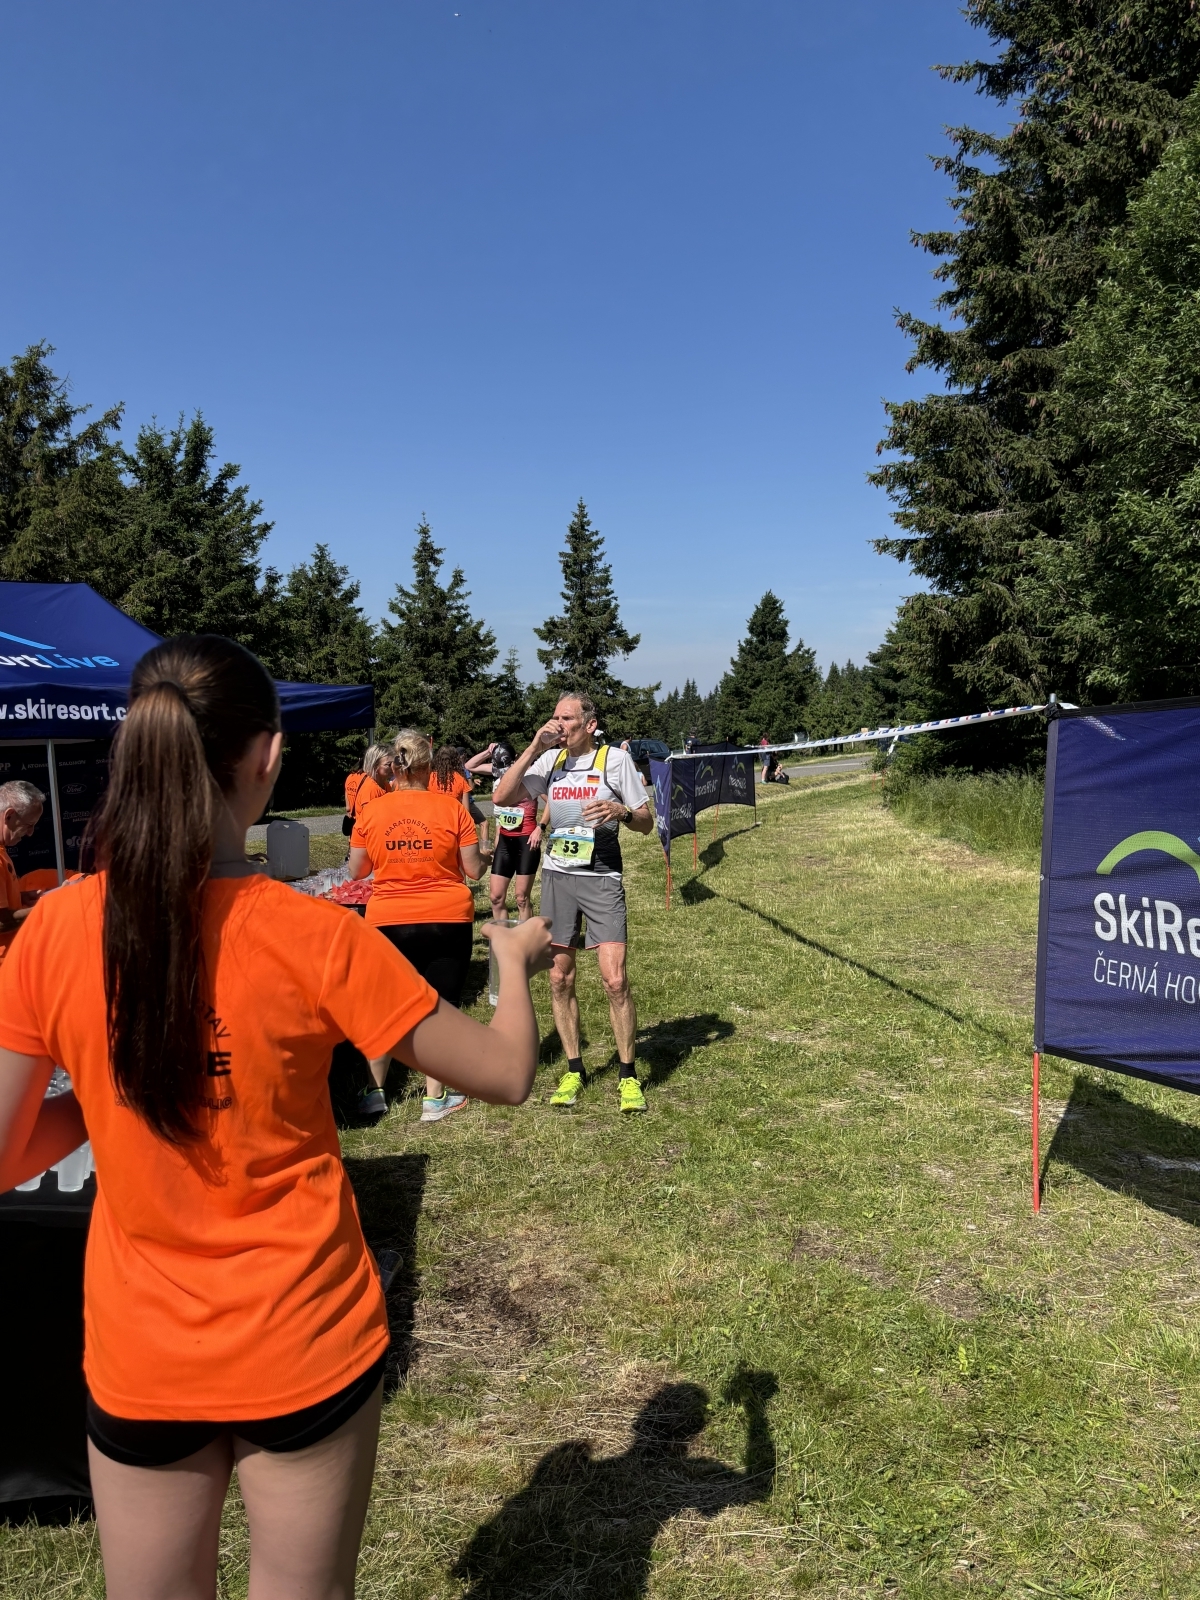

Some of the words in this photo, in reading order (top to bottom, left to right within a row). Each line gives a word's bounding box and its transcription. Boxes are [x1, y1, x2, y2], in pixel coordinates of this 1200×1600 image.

[0, 698, 129, 720] .skiresort.c
[552, 786, 598, 800] GERMANY
[385, 818, 431, 837] MARATONSTAV
[503, 815, 517, 824] 108
[563, 840, 579, 854] 53
[1094, 950, 1158, 996] ČERNÁ
[1165, 972, 1200, 1003] HO
